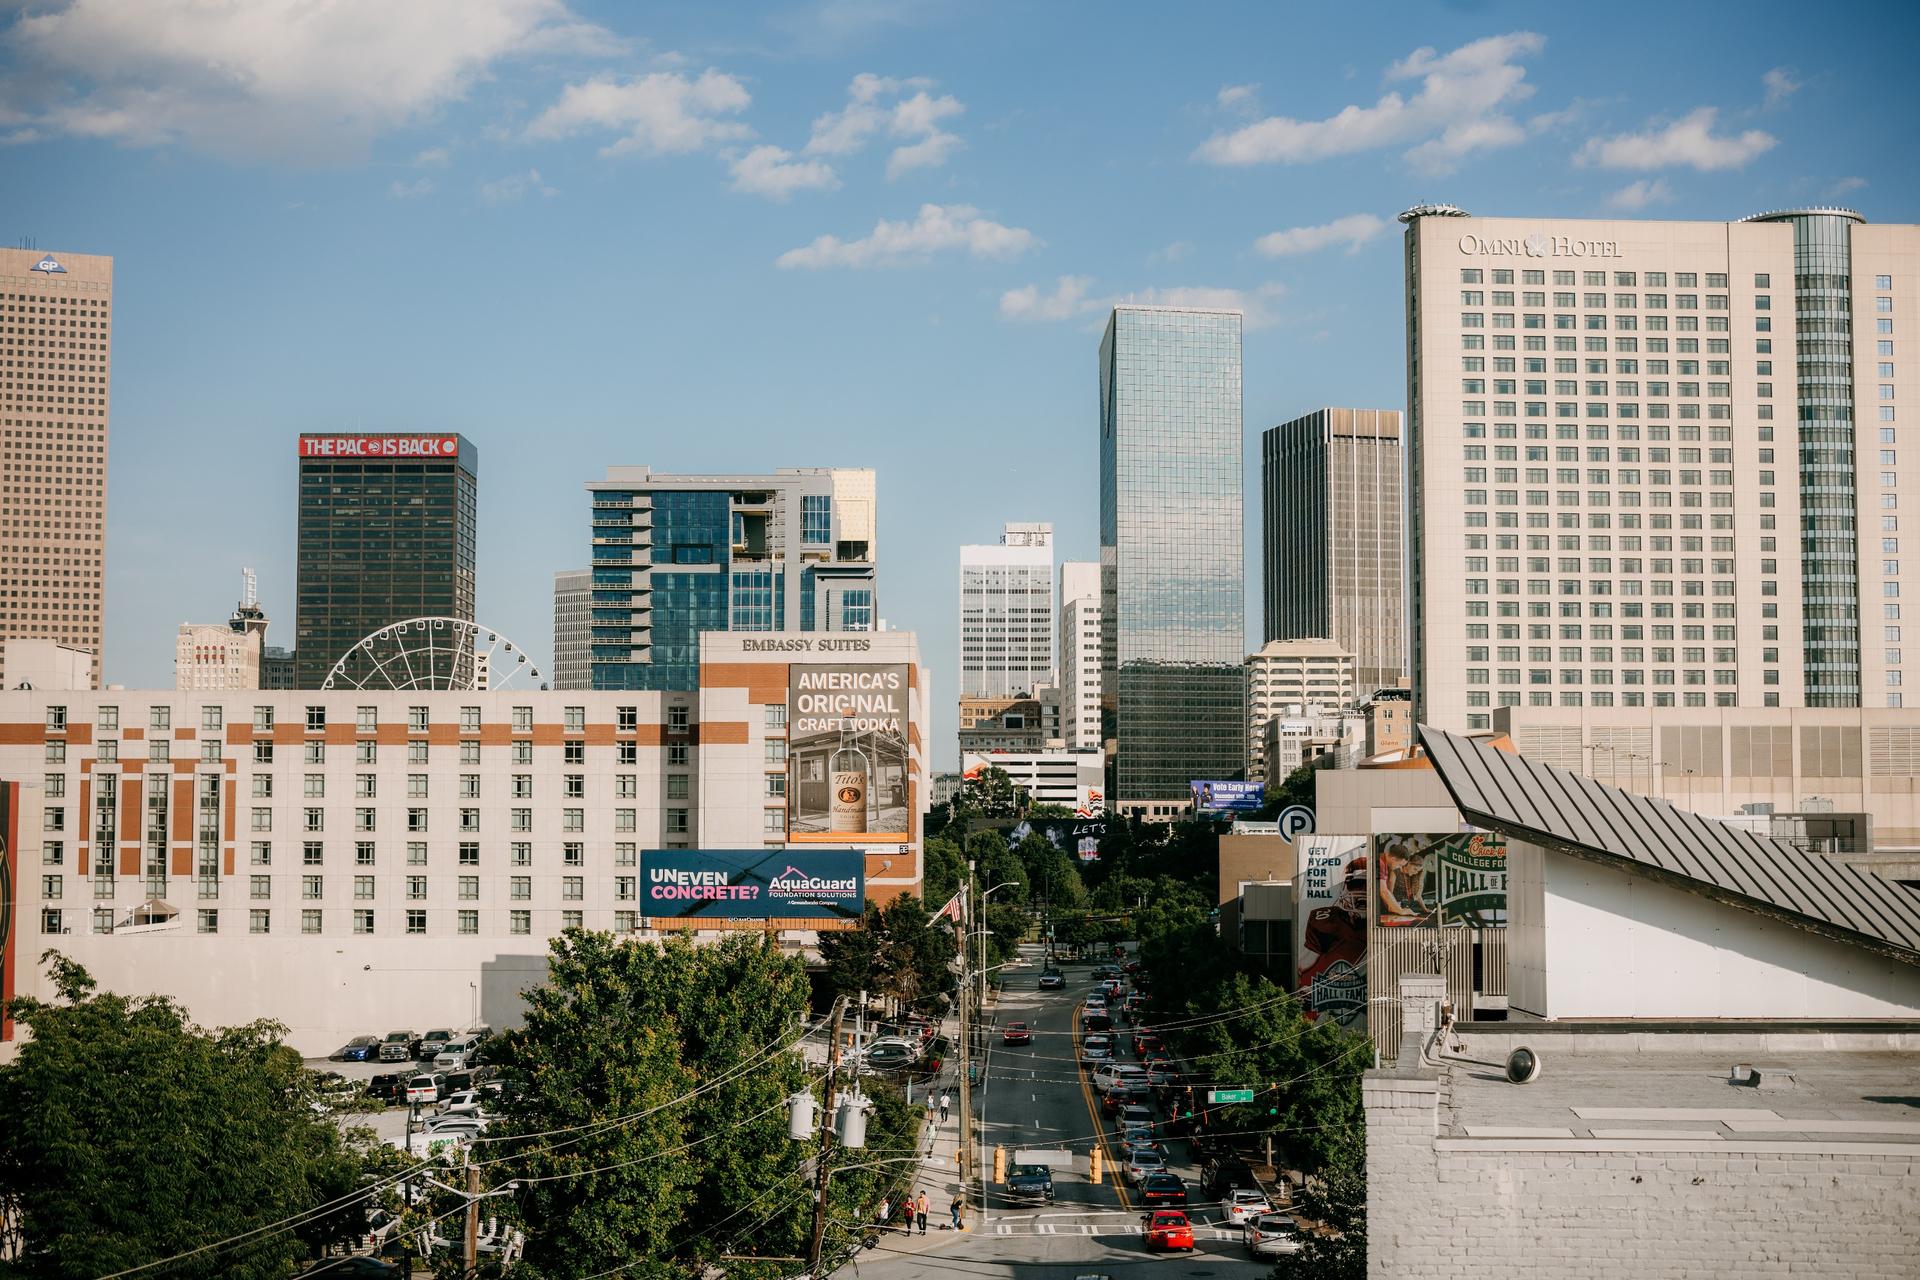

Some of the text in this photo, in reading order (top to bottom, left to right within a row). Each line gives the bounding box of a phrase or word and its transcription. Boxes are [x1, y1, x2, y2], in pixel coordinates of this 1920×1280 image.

[39, 260, 58, 270] GP
[304, 438, 440, 455] THE PAC IS BACK
[742, 638, 871, 652] EMBASSY SUITES
[798, 672, 900, 690] AMERICA'S
[797, 694, 900, 713] ORIGINAL
[797, 717, 899, 732] CRAFT VODKA
[835, 774, 865, 785] Tito's
[1212, 783, 1260, 793] Vote Early Here
[1072, 822, 1107, 835] LET'S
[1290, 815, 1307, 835] P
[1308, 847, 1327, 856] GET
[1308, 857, 1341, 866] HYPED
[1452, 852, 1491, 868] COLLEGE
[650, 868, 728, 886] UNEVEN
[1307, 868, 1327, 877] FOR
[769, 877, 857, 892] AquaGuard
[1307, 879, 1326, 888] THE
[1445, 865, 1489, 900] HALL
[1490, 878, 1498, 887] OF
[651, 885, 760, 900] CONCRETE?
[1307, 890, 1333, 899] HALL
[1316, 985, 1339, 1001] HALL
[1221, 1093, 1237, 1101] Baker
